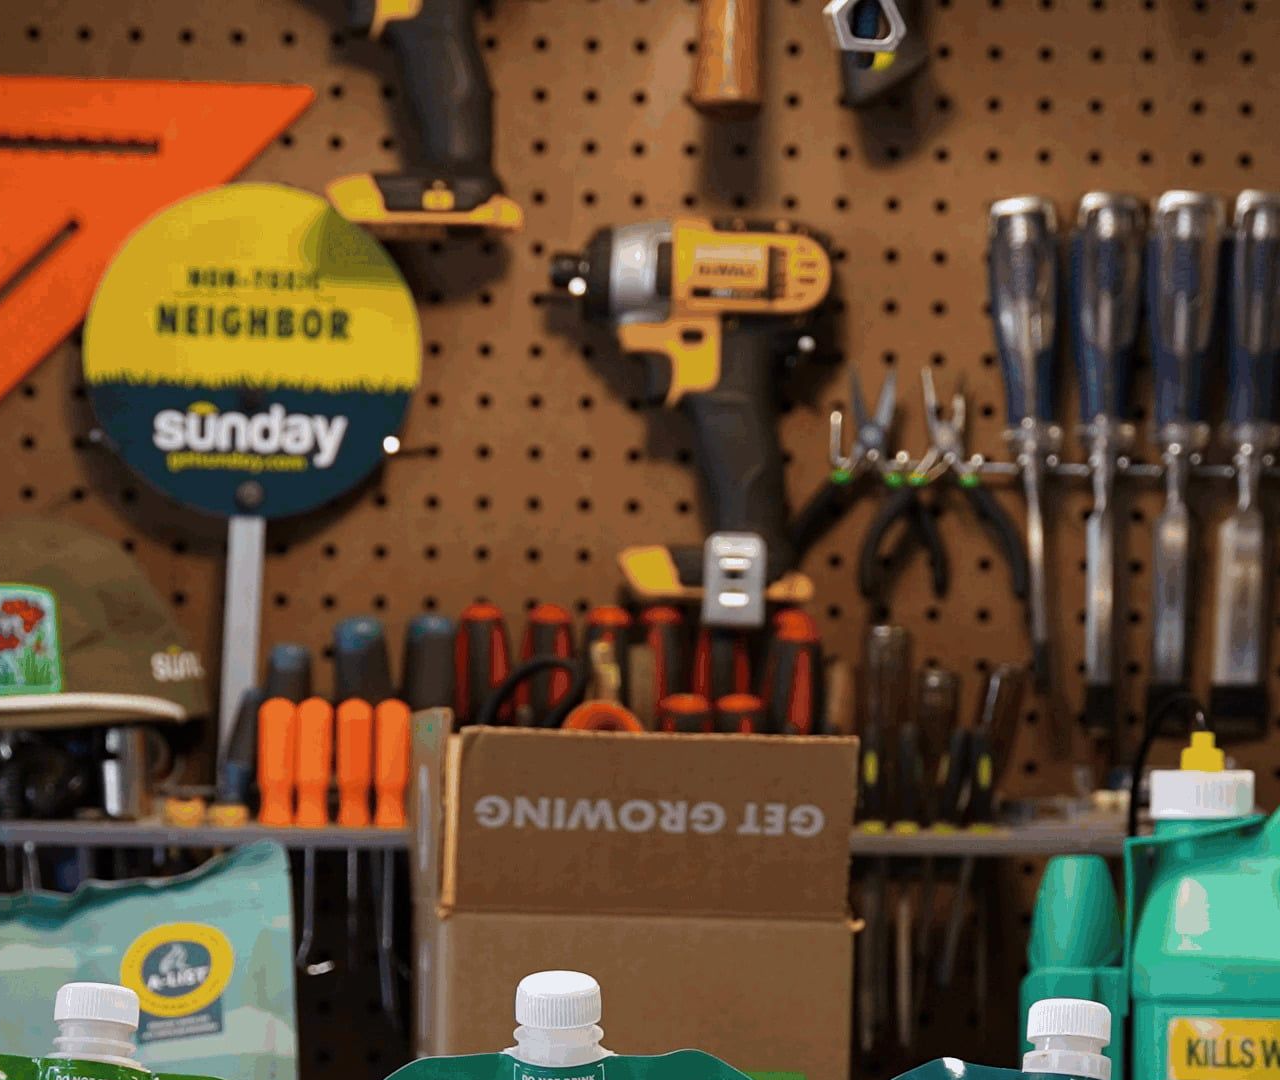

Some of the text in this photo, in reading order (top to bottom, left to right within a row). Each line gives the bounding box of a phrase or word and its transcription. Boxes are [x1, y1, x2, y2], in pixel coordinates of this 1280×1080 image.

[155, 303, 351, 341] NEIGHBOR
[152, 402, 349, 469] sunday
[474, 794, 825, 838] GET GROWING
[1186, 1039, 1255, 1069] KILLS
